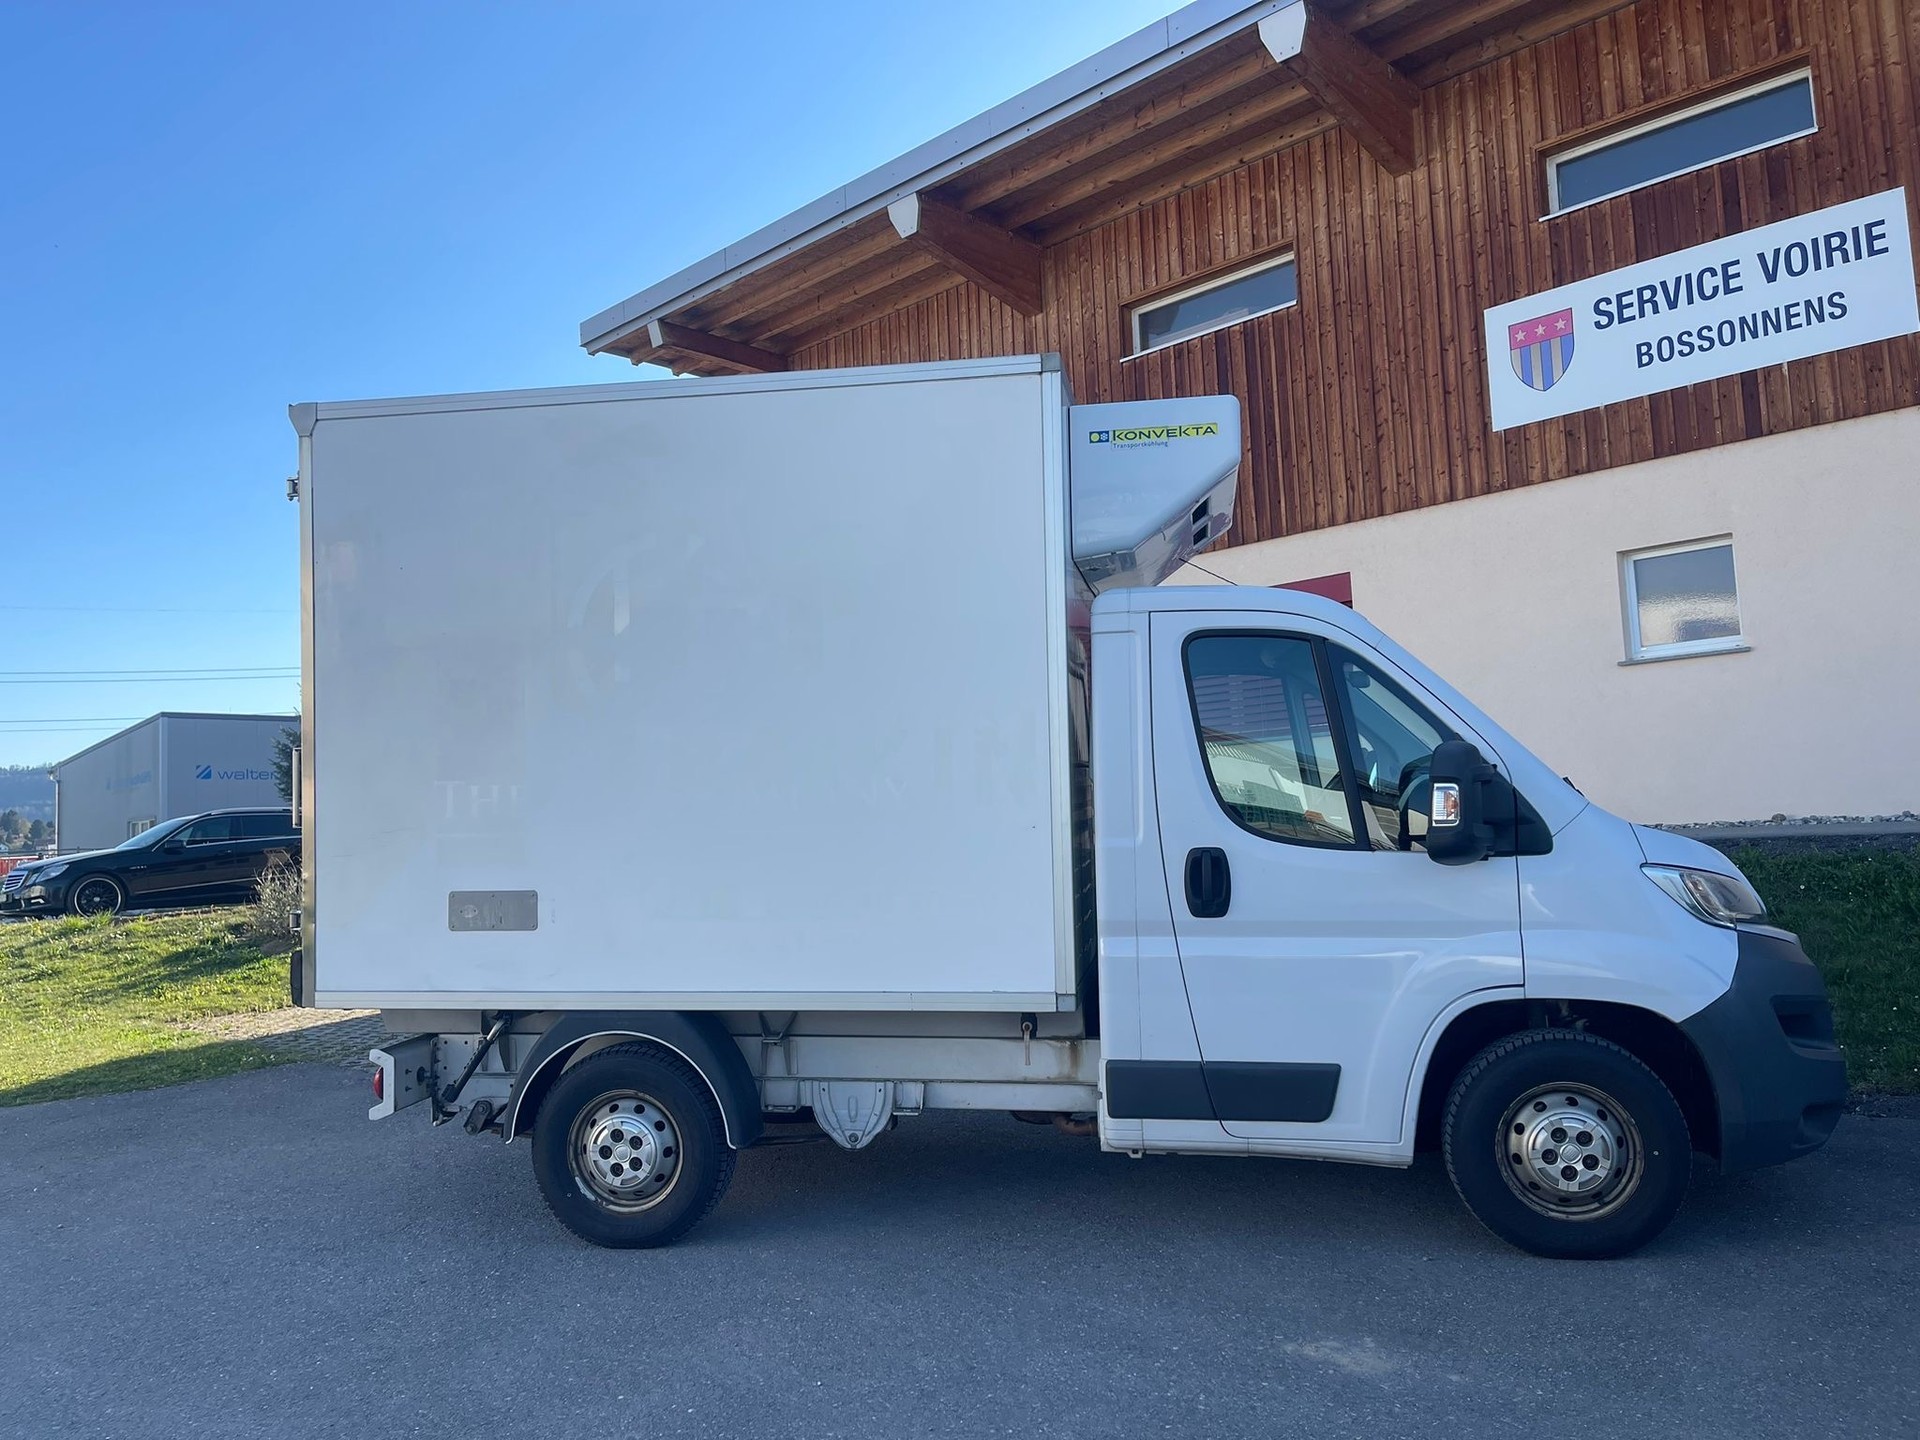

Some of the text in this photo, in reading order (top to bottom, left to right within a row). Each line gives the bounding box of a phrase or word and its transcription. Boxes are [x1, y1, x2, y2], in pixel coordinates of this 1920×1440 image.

[1593, 219, 1889, 330] SERVICE VOIRIE
[1636, 291, 1848, 369] BOSSONNENS
[1113, 425, 1216, 441] KONVEKTA
[217, 768, 276, 780] walter
